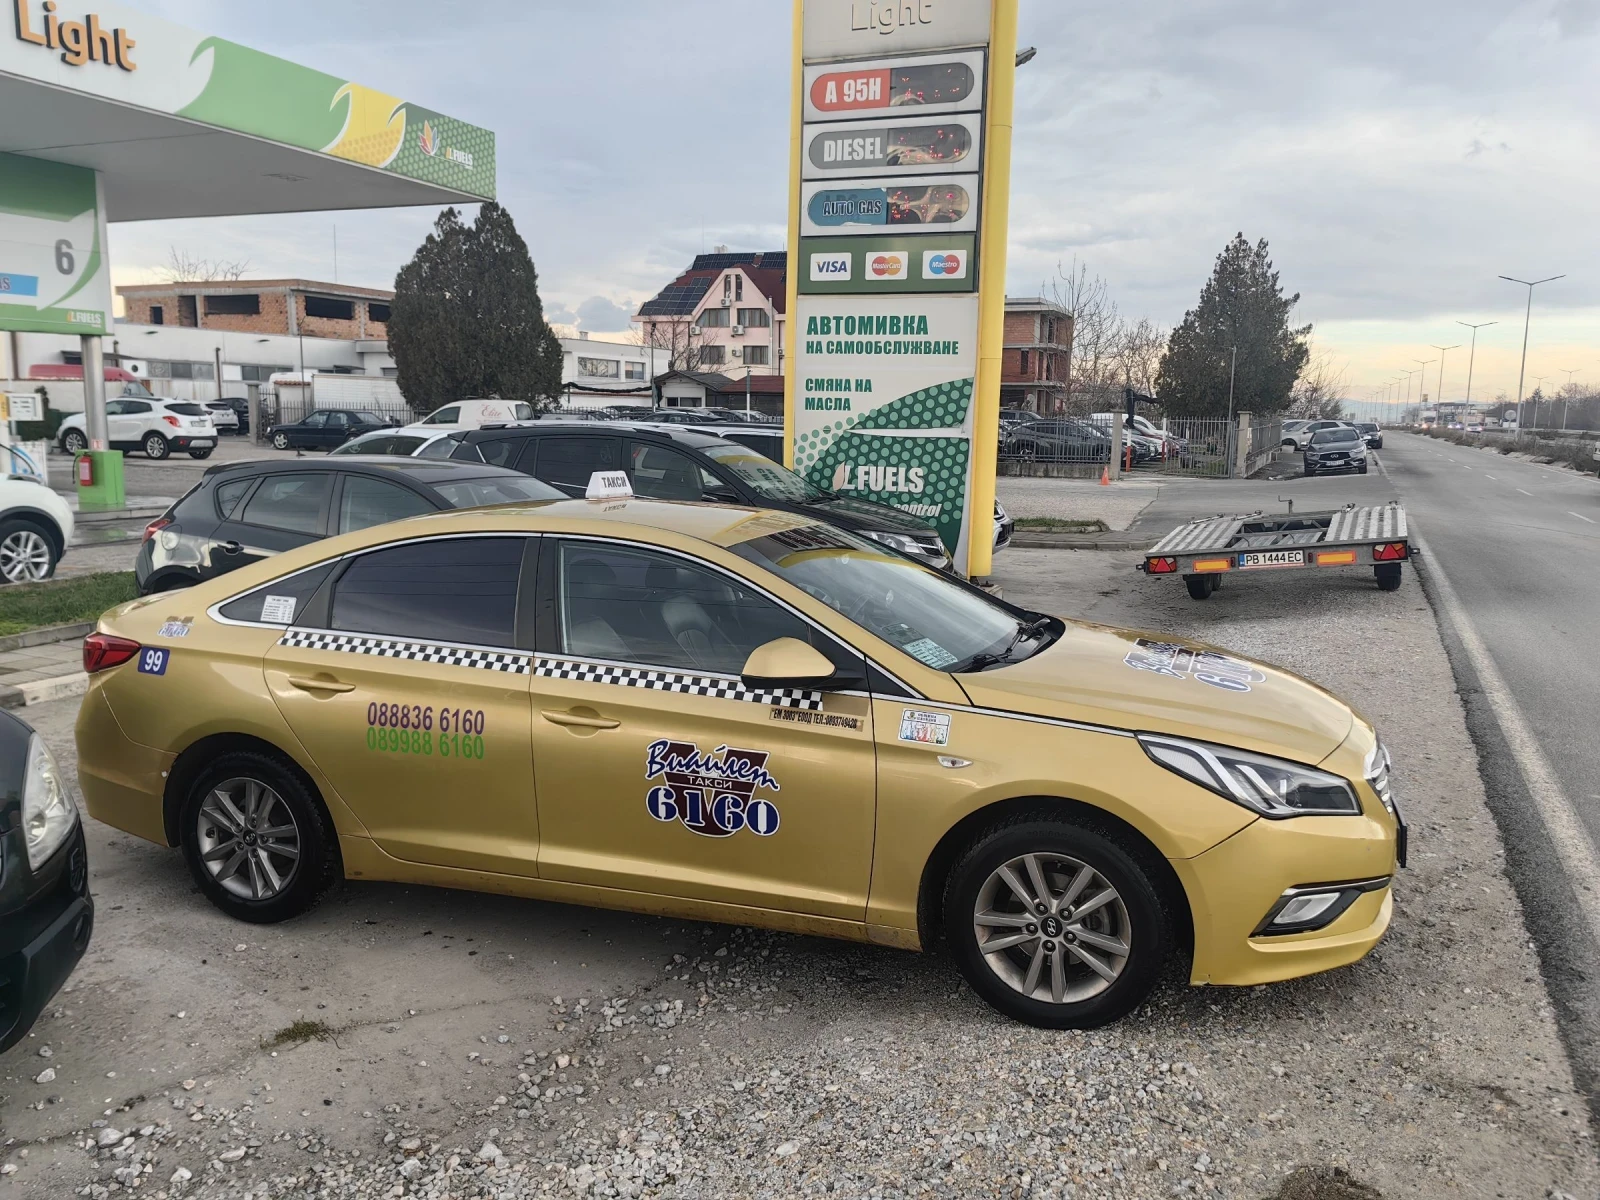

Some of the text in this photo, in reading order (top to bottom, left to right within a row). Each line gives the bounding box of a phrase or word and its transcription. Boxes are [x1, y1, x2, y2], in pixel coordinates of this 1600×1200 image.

[851, 0, 932, 35] Light
[13, 0, 137, 71] Light
[824, 77, 881, 104] A 95H
[823, 137, 883, 162] DIESEL
[823, 199, 882, 216] AUTO GAS
[54, 239, 75, 275] 6
[872, 262, 901, 270] MasterCard
[931, 260, 958, 269] Maestro
[816, 261, 847, 273] VISA
[806, 315, 929, 336] АВТОМИВКА
[806, 340, 959, 355] НА САМООБСЛУЖВАНЕ
[805, 378, 872, 393] СМЯНА НА
[804, 397, 851, 411] МАСЛА
[601, 476, 627, 488] ТАКСИ
[1262, 552, 1286, 564] 1444
[144, 649, 163, 672] 99
[367, 701, 485, 736] 088836 6160
[366, 726, 485, 760] 089988 6160
[687, 775, 733, 789] ТАКСИ
[646, 785, 780, 836] 6160
